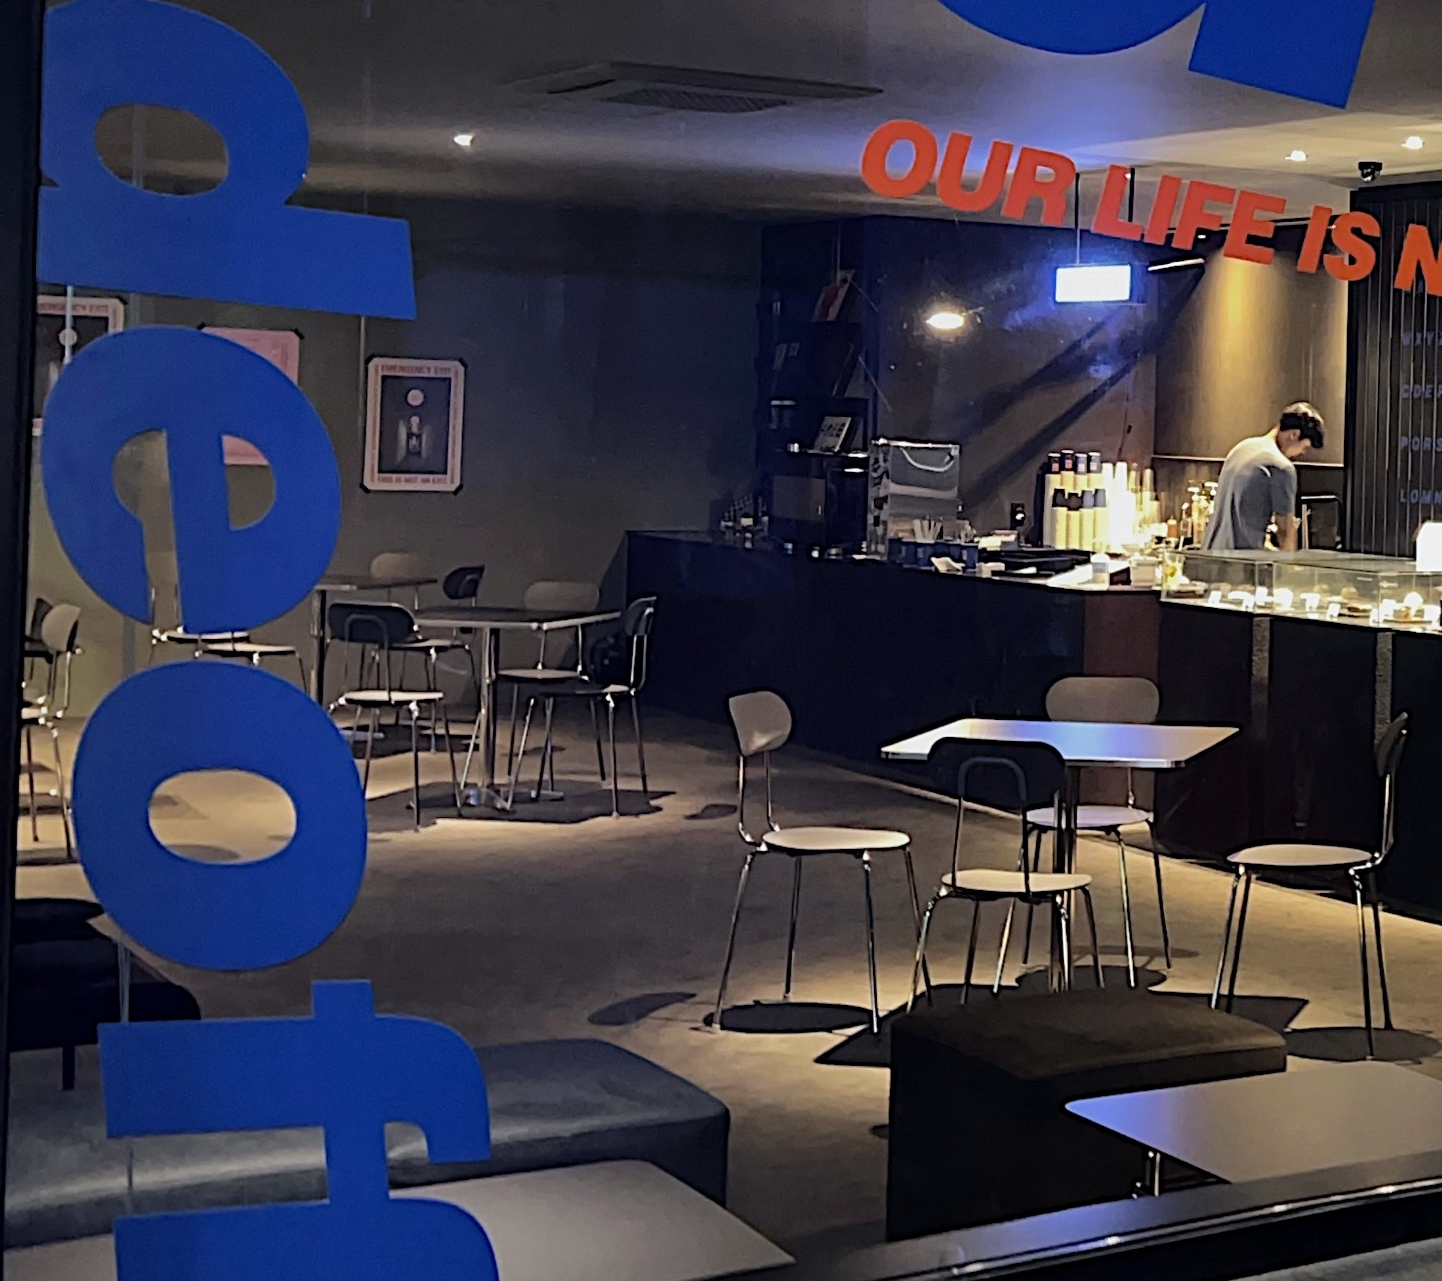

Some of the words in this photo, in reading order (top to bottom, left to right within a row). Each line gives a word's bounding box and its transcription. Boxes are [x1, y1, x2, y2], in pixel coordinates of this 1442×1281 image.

[860, 118, 1077, 228] OUR
[1090, 164, 1287, 265] LIFE
[1296, 205, 1381, 282] IS
